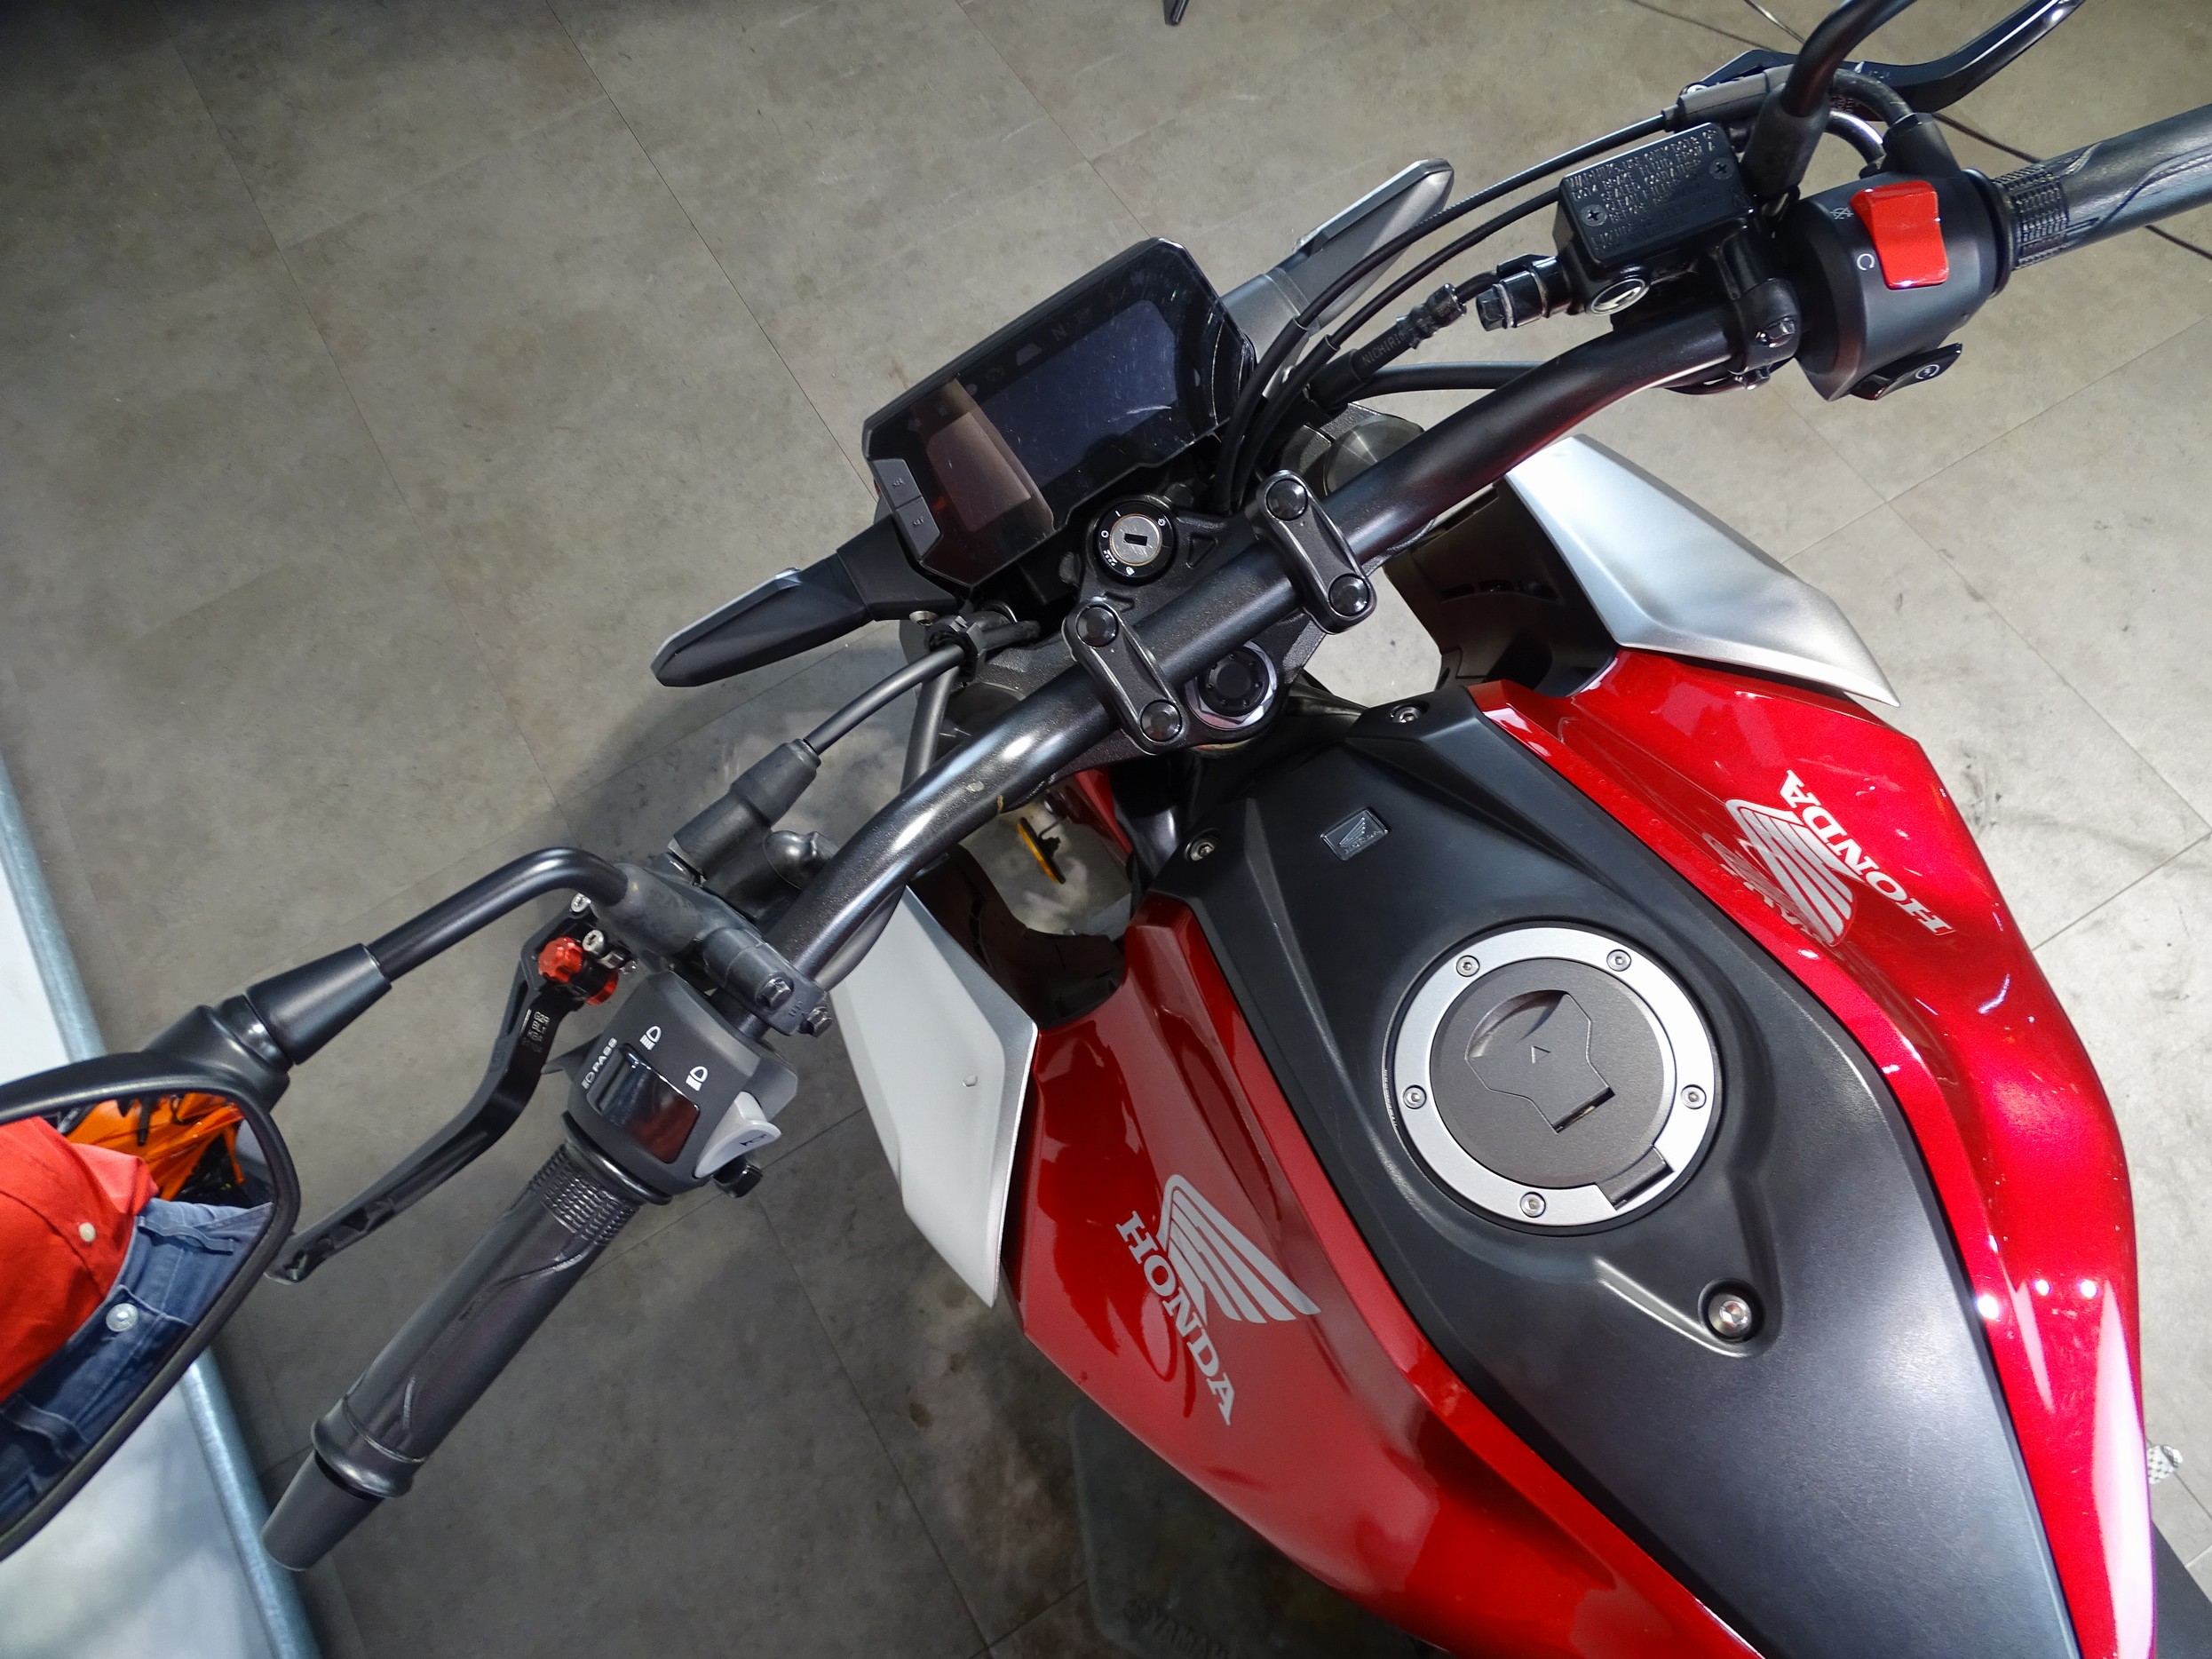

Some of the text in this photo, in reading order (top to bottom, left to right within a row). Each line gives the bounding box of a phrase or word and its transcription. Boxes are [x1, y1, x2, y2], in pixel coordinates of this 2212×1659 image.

[1779, 769, 1955, 936] HONDA
[594, 1037, 618, 1073] PASS
[1115, 1210, 1236, 1426] HONDA
